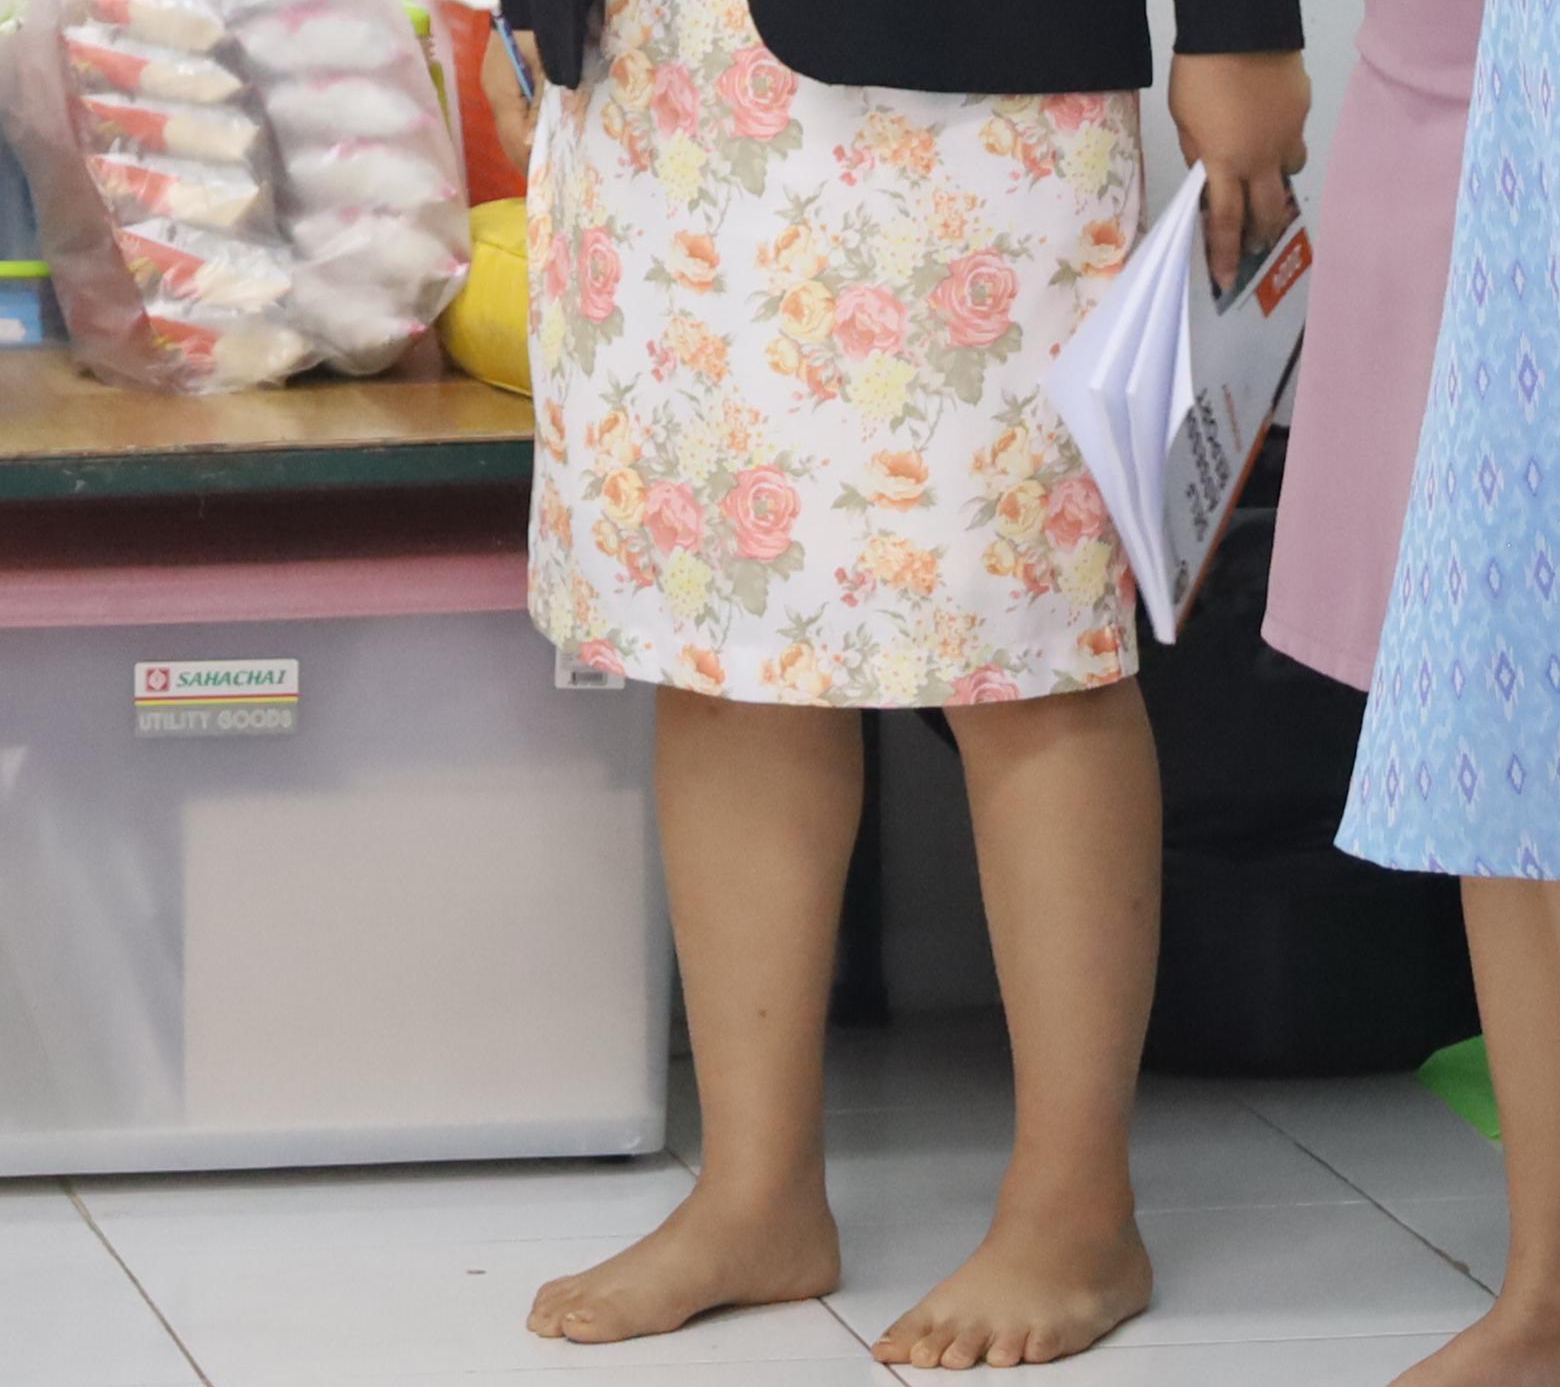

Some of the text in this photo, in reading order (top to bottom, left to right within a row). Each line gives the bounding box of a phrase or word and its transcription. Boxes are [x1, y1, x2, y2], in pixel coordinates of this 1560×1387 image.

[176, 669, 288, 688] SAHACHAI
[138, 708, 292, 732] UTILITY GOODS
